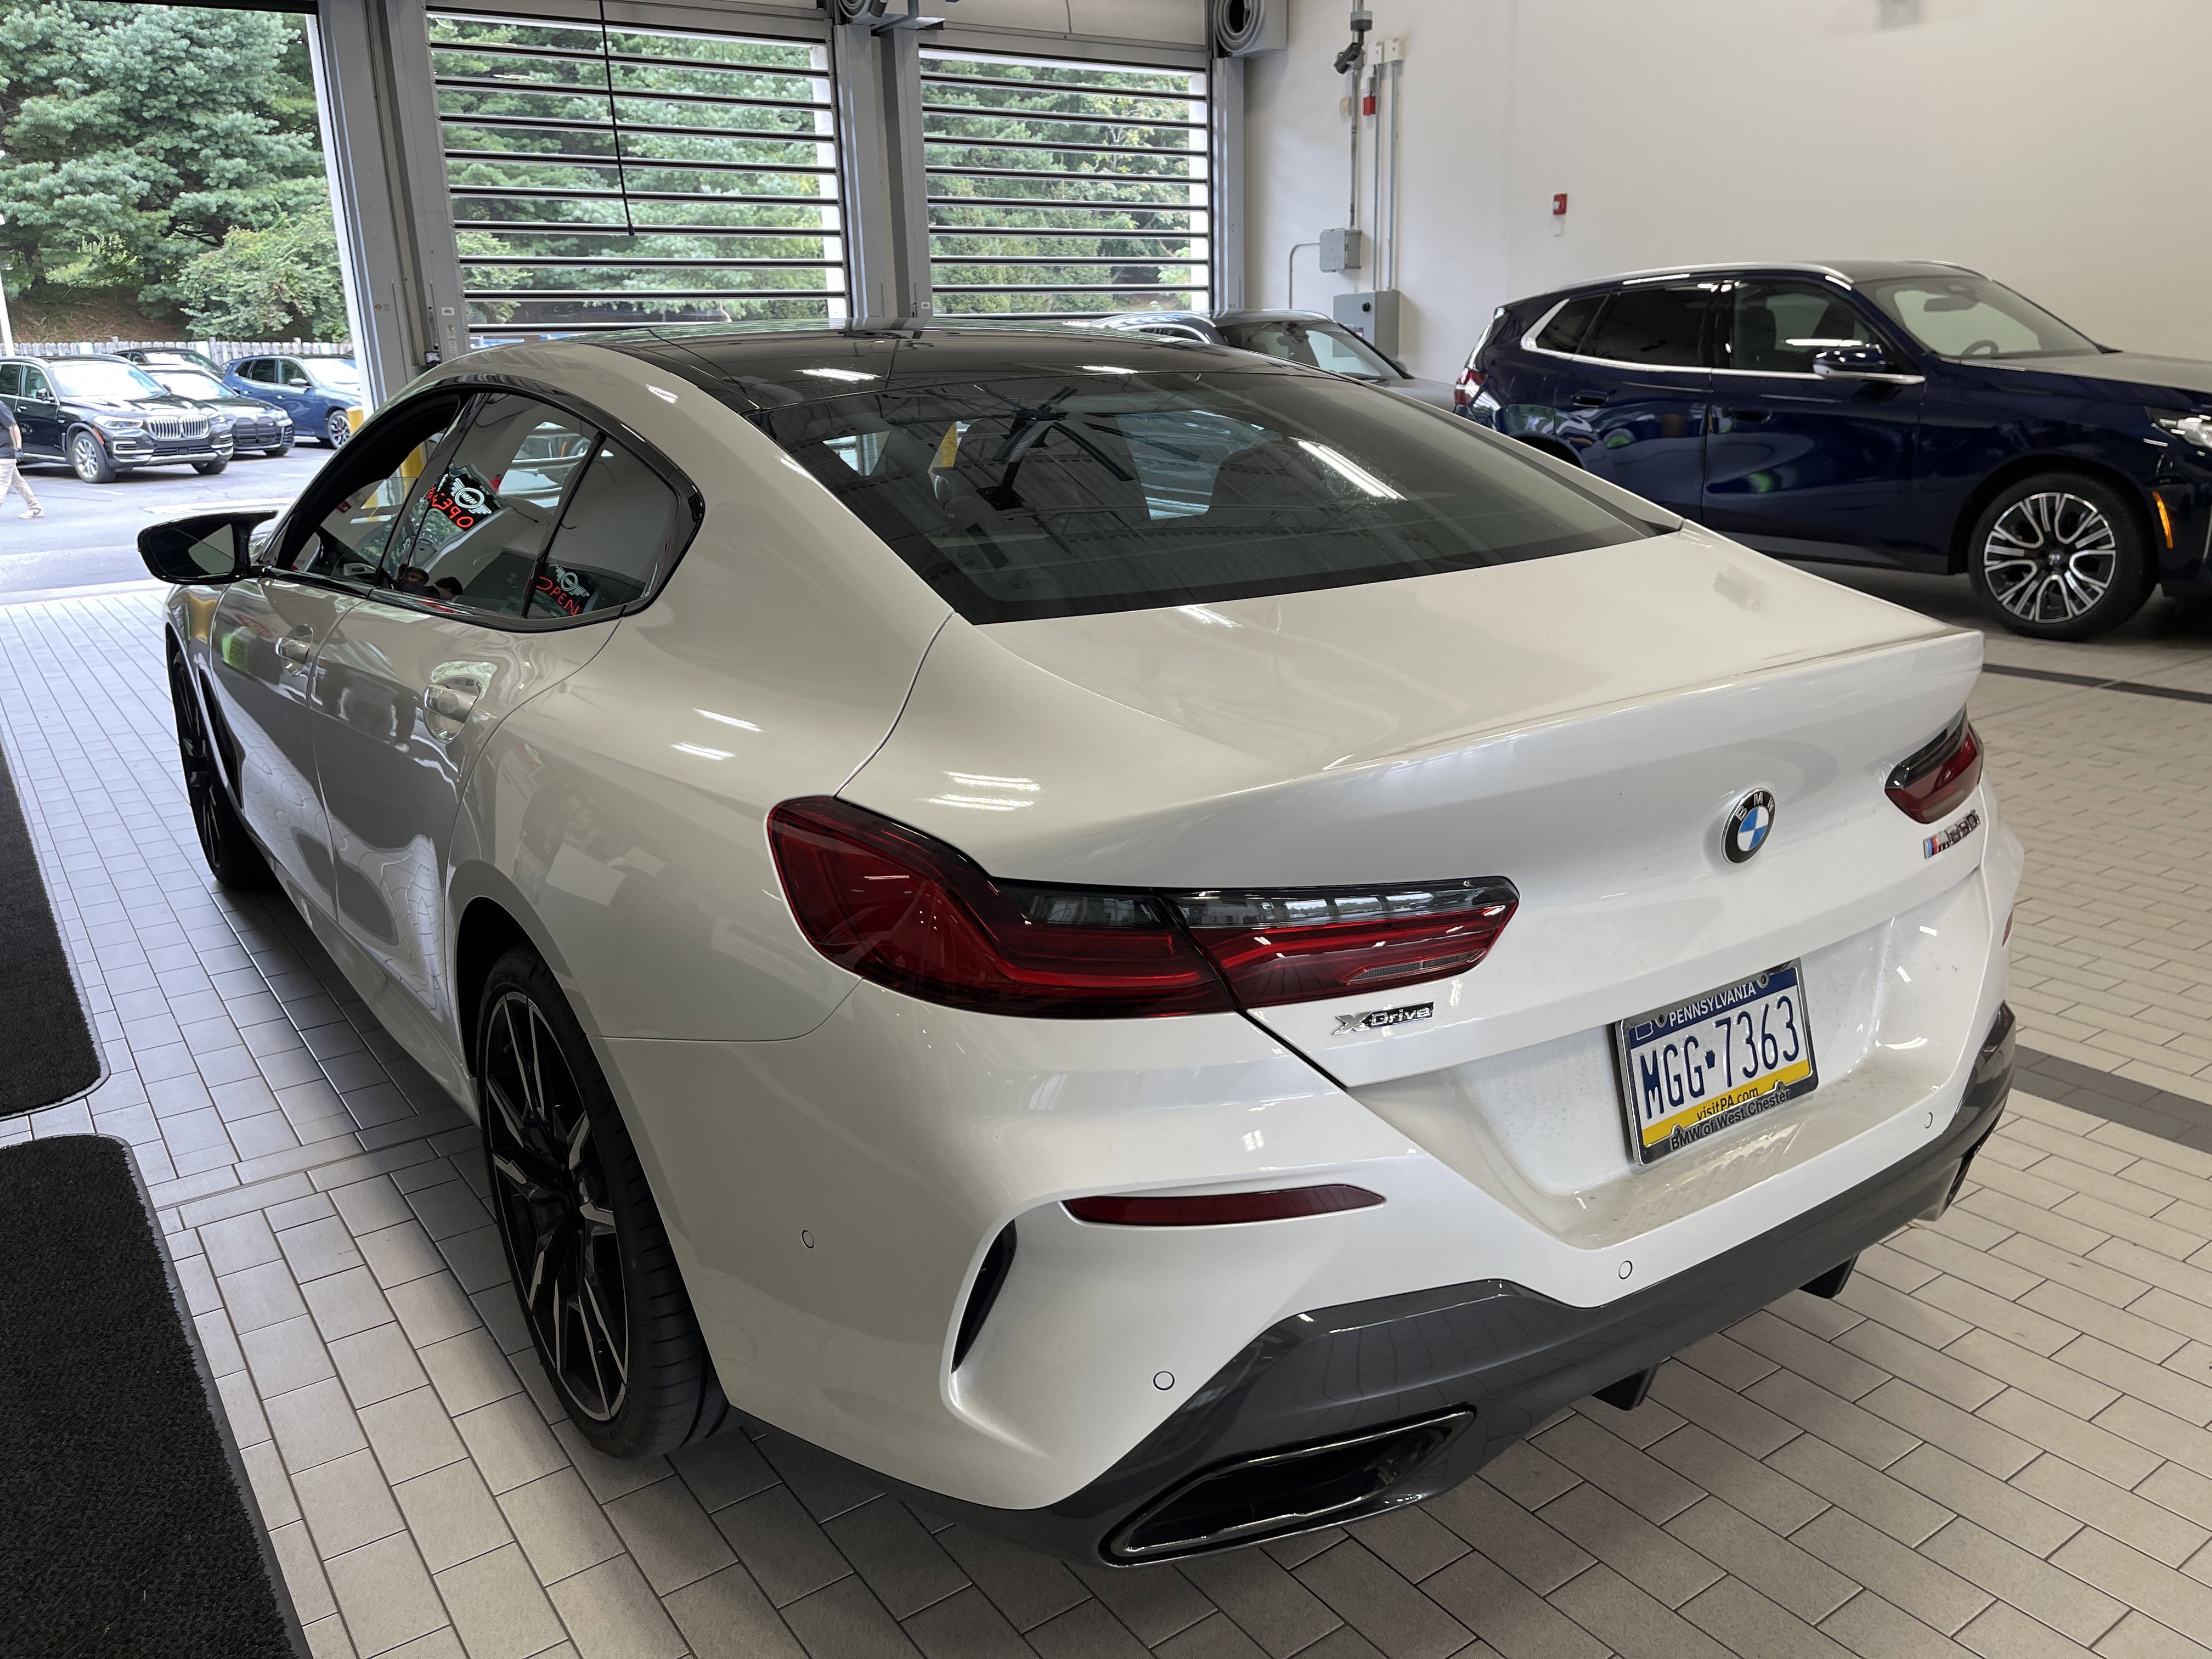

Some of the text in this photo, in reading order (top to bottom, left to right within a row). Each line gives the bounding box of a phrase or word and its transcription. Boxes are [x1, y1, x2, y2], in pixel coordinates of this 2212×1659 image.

[1669, 982, 1757, 1028] PENNSYLVANIA
[1670, 1088, 1791, 1151] BMW of West Chester
[1696, 1087, 1758, 1120] visitPA.com
